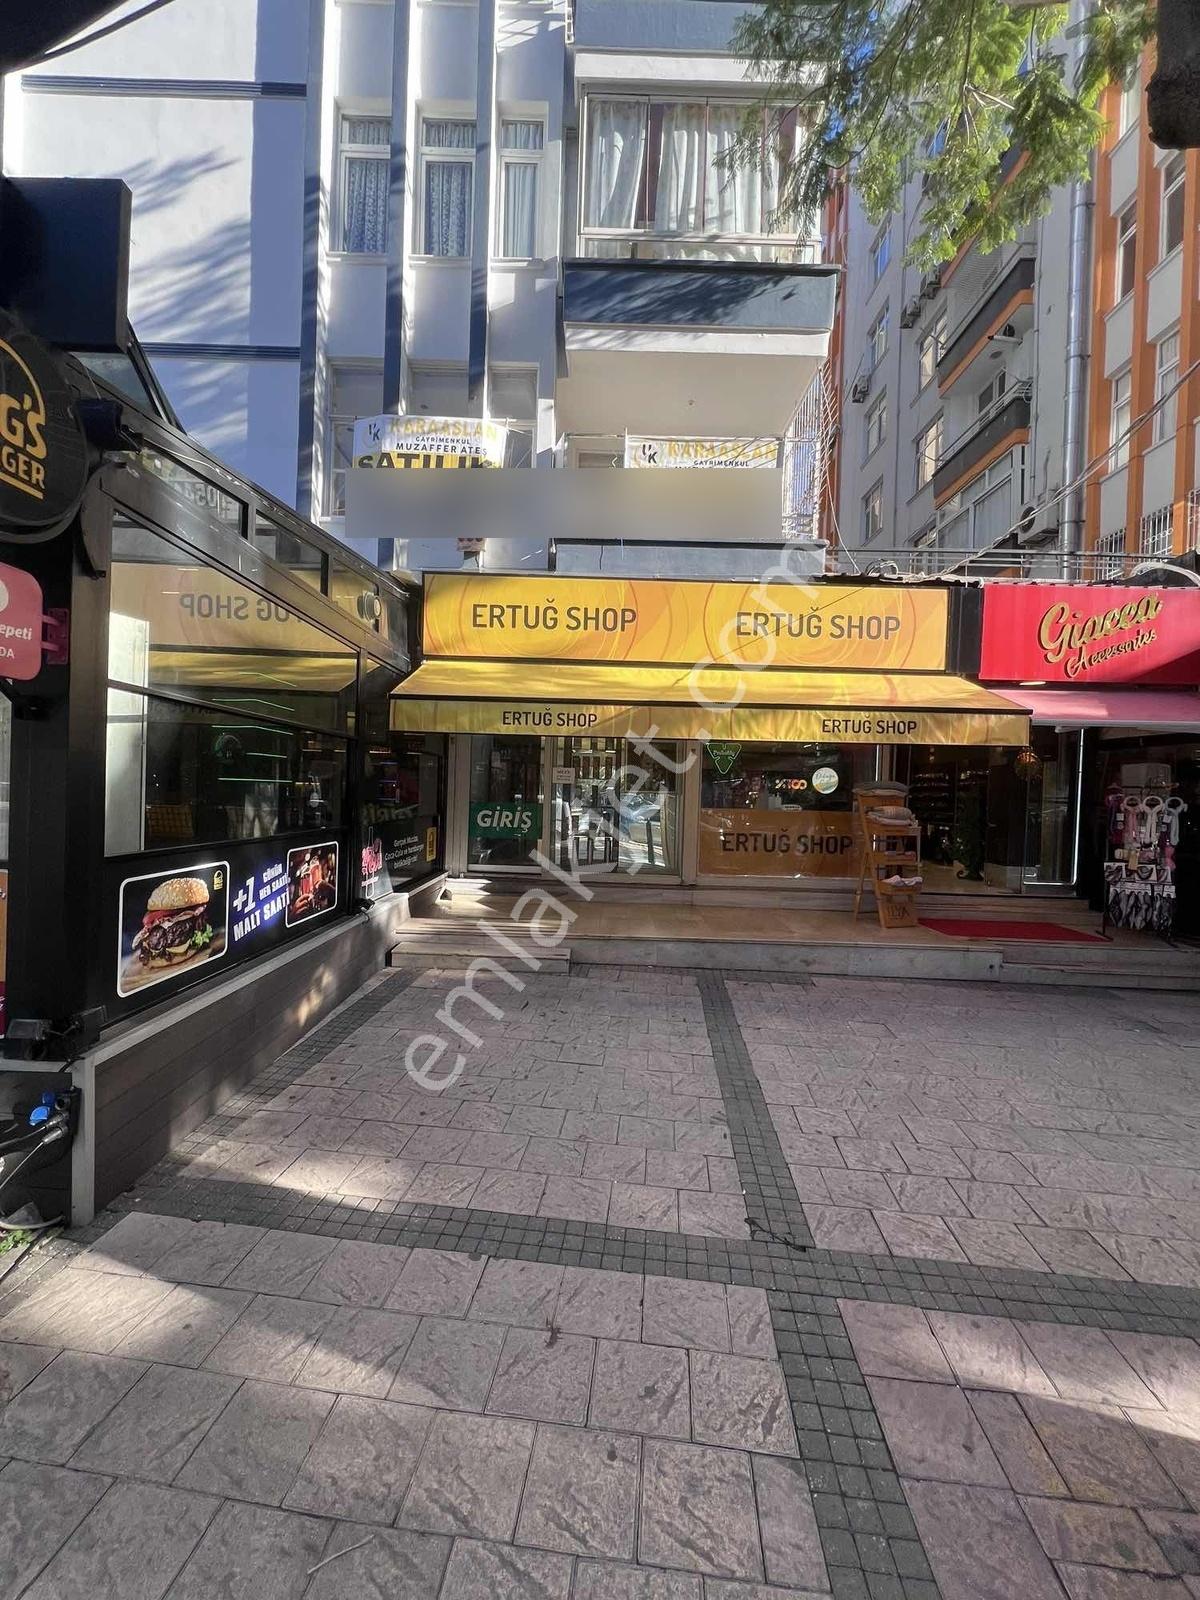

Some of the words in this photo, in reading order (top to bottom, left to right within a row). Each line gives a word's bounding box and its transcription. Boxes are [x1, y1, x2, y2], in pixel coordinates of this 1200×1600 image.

[396, 443, 457, 453] MUZAFFER
[472, 598, 559, 630] ERTUĞ
[566, 606, 637, 632] SHOP
[736, 606, 822, 638] ERTUĞ
[829, 614, 900, 640] SHOP
[502, 707, 552, 726] ERTUĞ
[556, 712, 597, 727] SHOP
[822, 714, 872, 734] ERTUĞ
[876, 720, 917, 734] SHOP
[477, 806, 532, 833] GİRİŞ
[722, 828, 791, 853] ERTUĞ
[797, 834, 853, 855] SHOP
[233, 876, 256, 914] +1
[259, 884, 272, 900] HER
[233, 909, 261, 942] MALT
[263, 887, 290, 921] SAATİ
